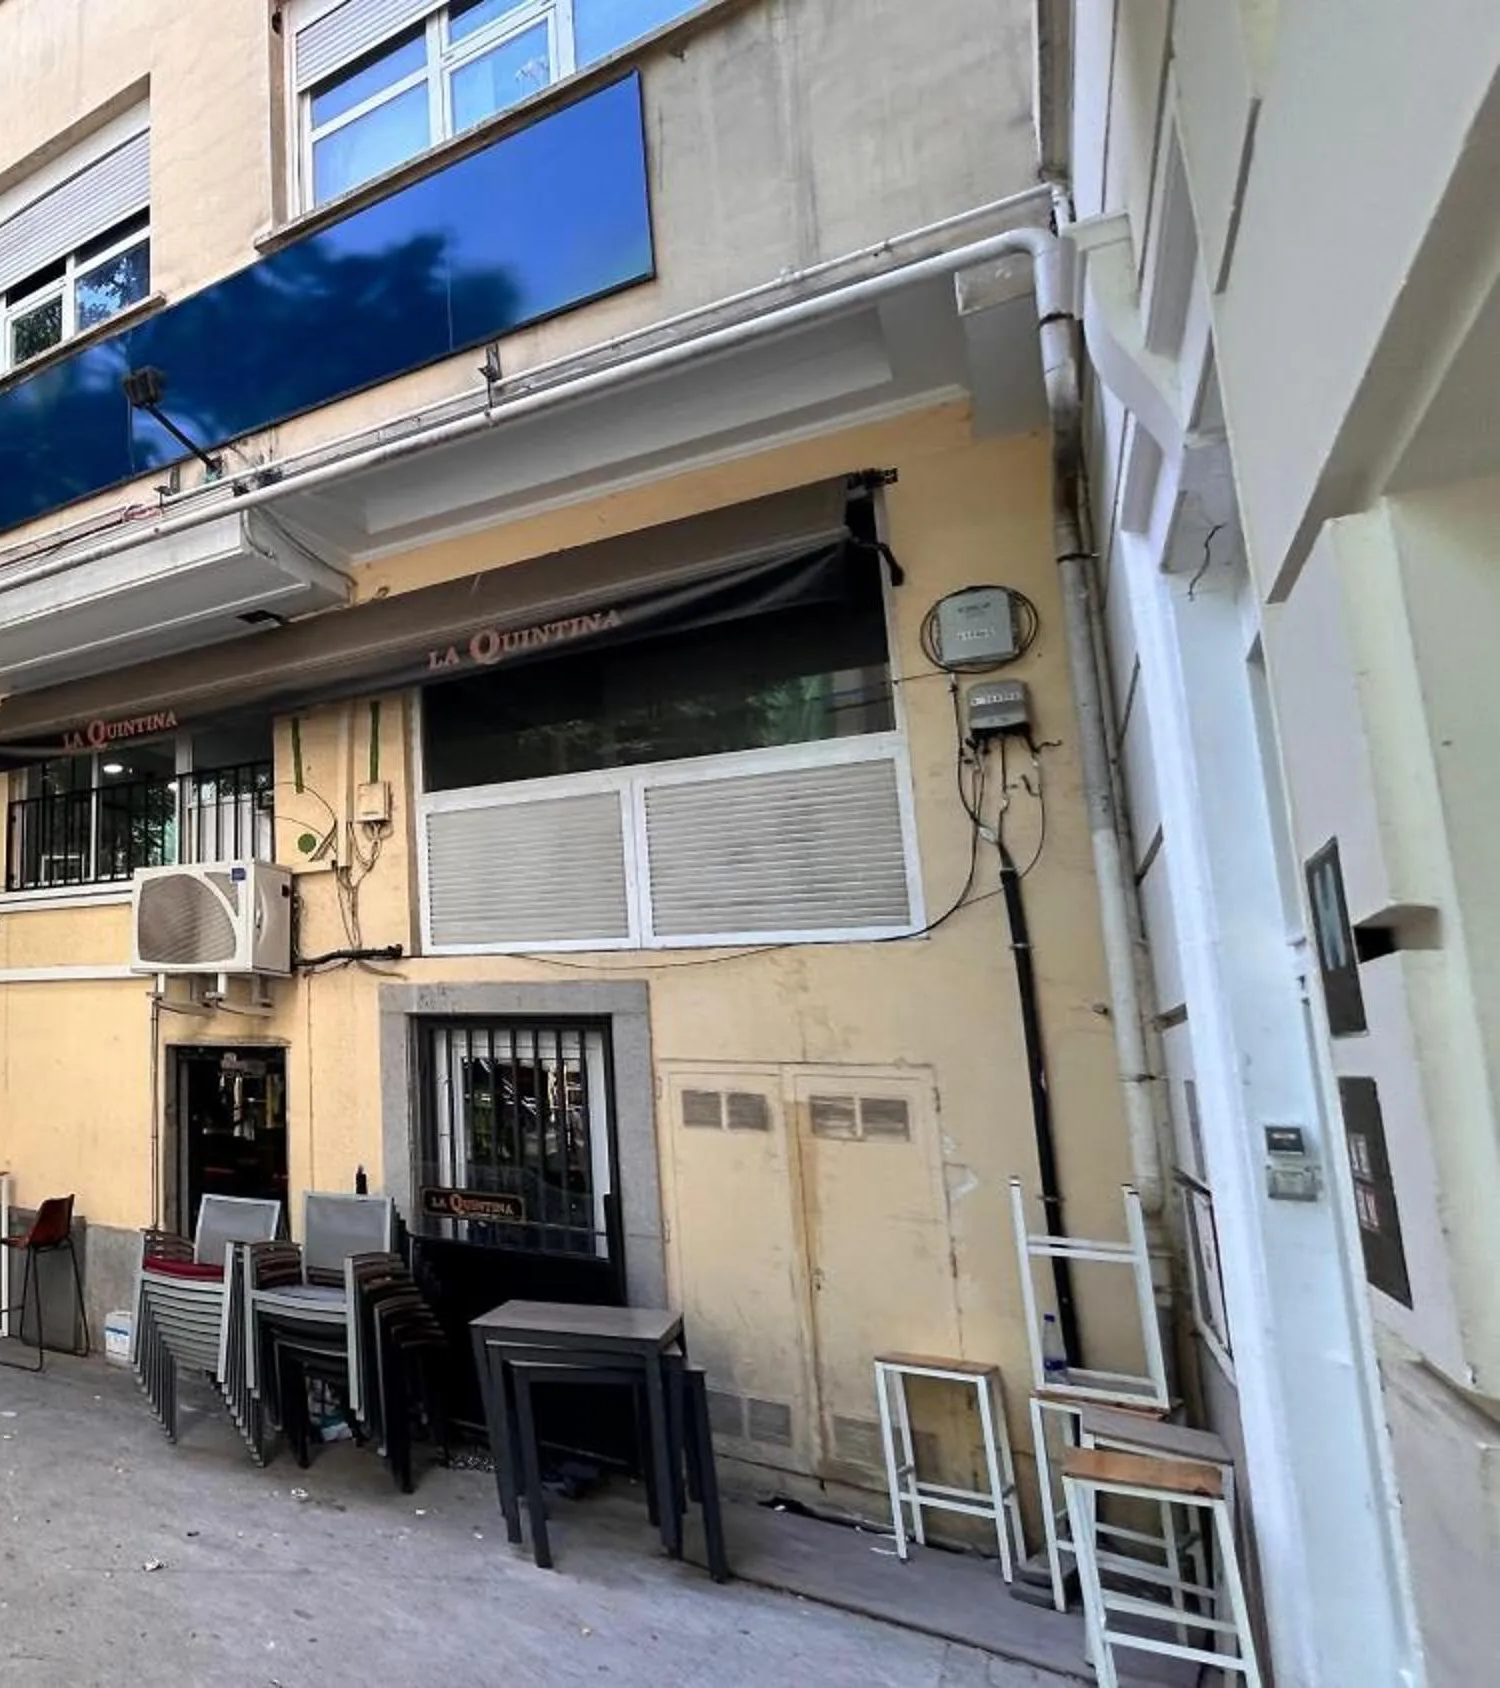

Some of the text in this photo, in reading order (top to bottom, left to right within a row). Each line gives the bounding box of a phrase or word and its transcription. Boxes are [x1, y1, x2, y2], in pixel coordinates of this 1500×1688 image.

[428, 609, 624, 671] LA QUINTINA
[62, 709, 179, 750] LA QUINTINA
